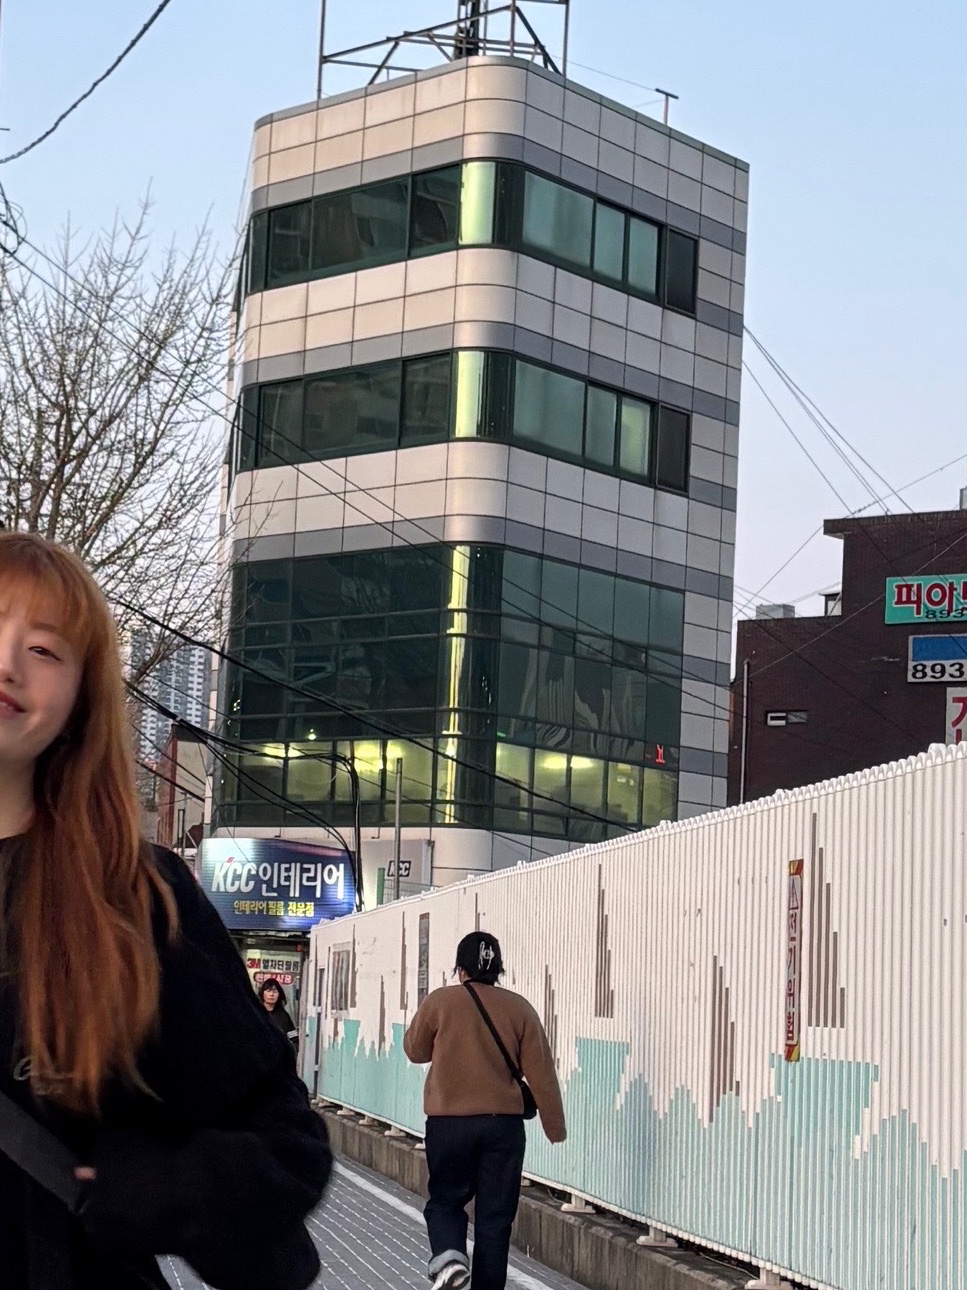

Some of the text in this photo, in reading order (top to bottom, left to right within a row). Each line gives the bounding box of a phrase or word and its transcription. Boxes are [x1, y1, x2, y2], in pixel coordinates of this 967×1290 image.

[925, 609, 965, 620] 893
[911, 662, 965, 680] 893
[287, 902, 315, 917] 전문점
